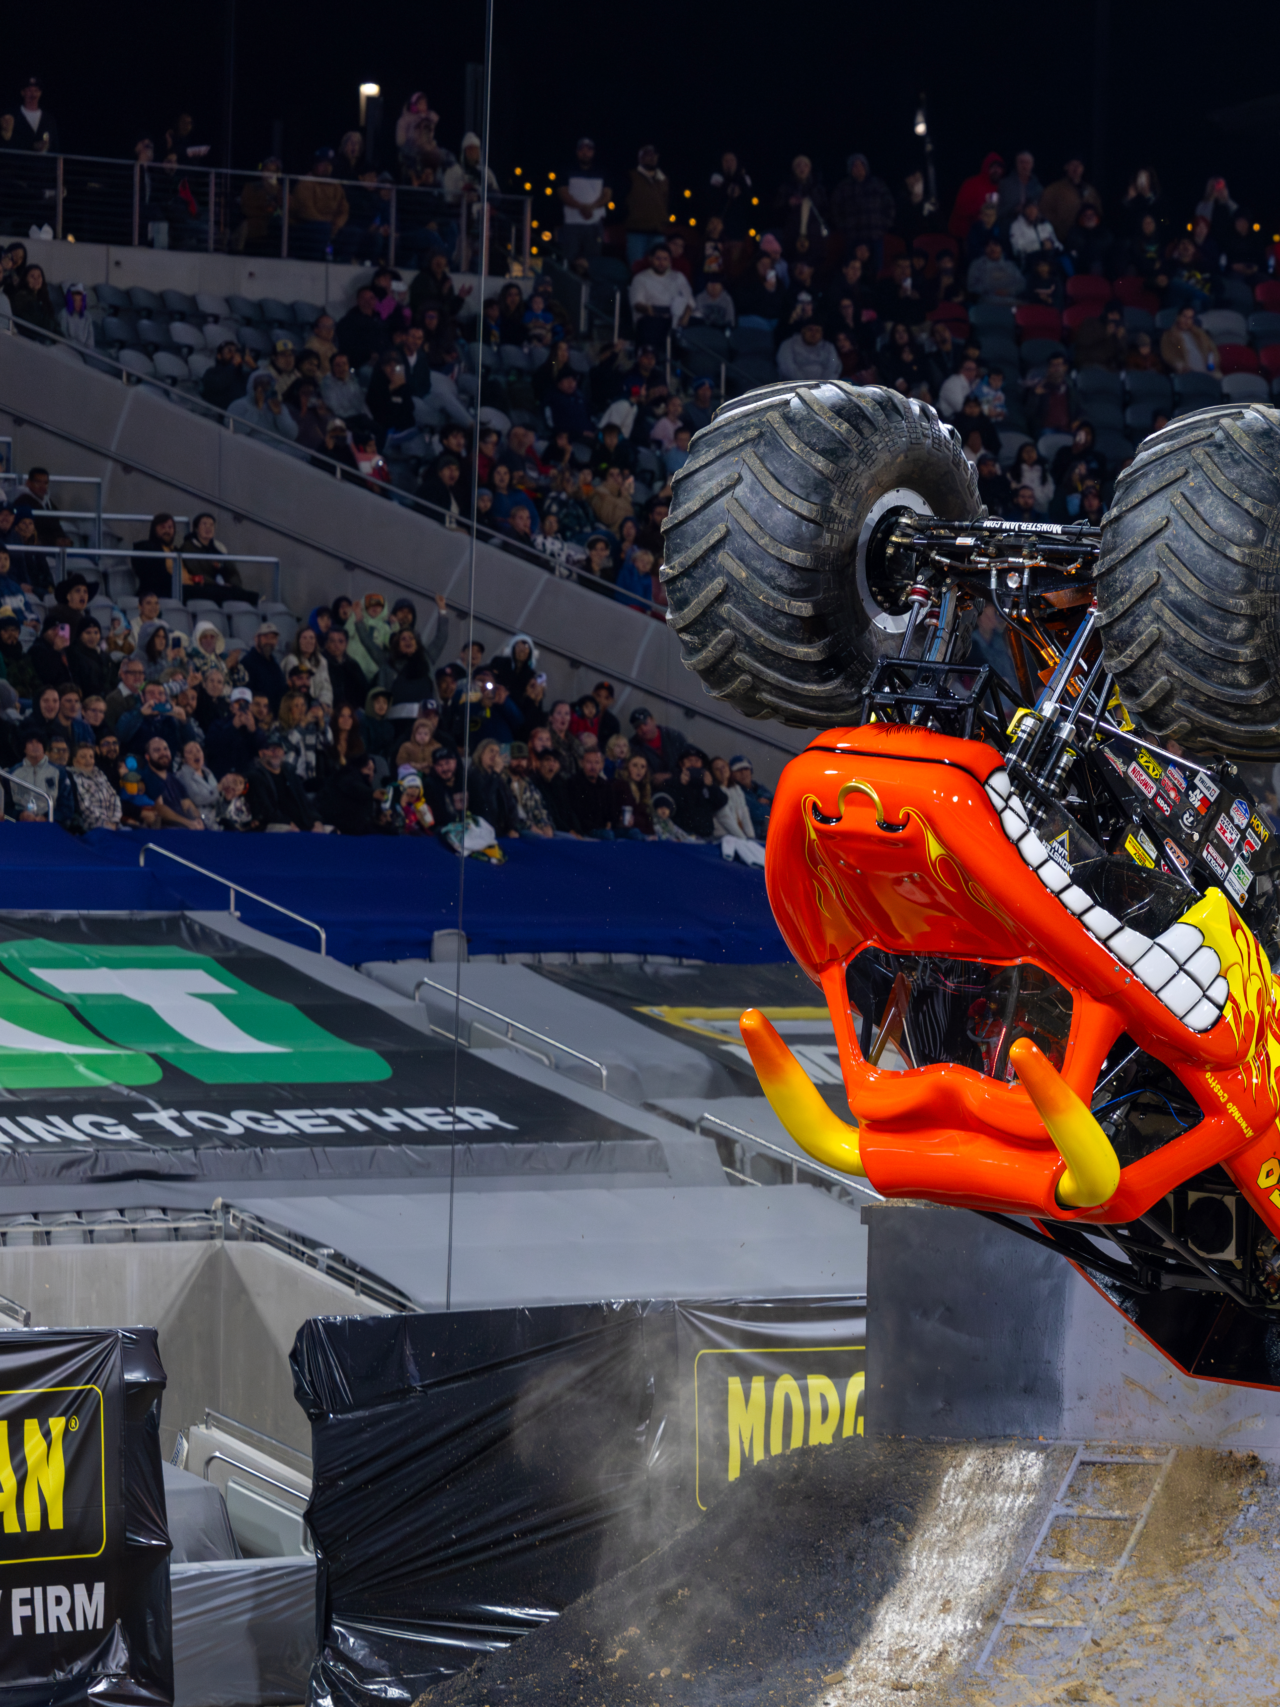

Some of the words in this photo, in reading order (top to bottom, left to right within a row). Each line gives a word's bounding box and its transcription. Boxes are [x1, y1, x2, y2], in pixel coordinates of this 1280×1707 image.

[1130, 765, 1154, 795] SIMPSON
[1198, 775, 1213, 793] OPTIMA
[1155, 795, 1171, 816] Coan
[1220, 819, 1234, 836] ROD
[1222, 815, 1240, 837] ENDS
[1249, 814, 1270, 844] UNOH
[1041, 839, 1075, 875] MONSTER
[1051, 840, 1069, 858] JAM
[1208, 846, 1224, 867] WELDERS
[1206, 853, 1225, 878] LINCOLN
[1232, 865, 1250, 886] BKT
[1203, 1071, 1229, 1103] Castro
[0, 1113, 142, 1142] ING
[132, 1106, 519, 1137] TOGETHER
[11, 1582, 105, 1636] FIRM
